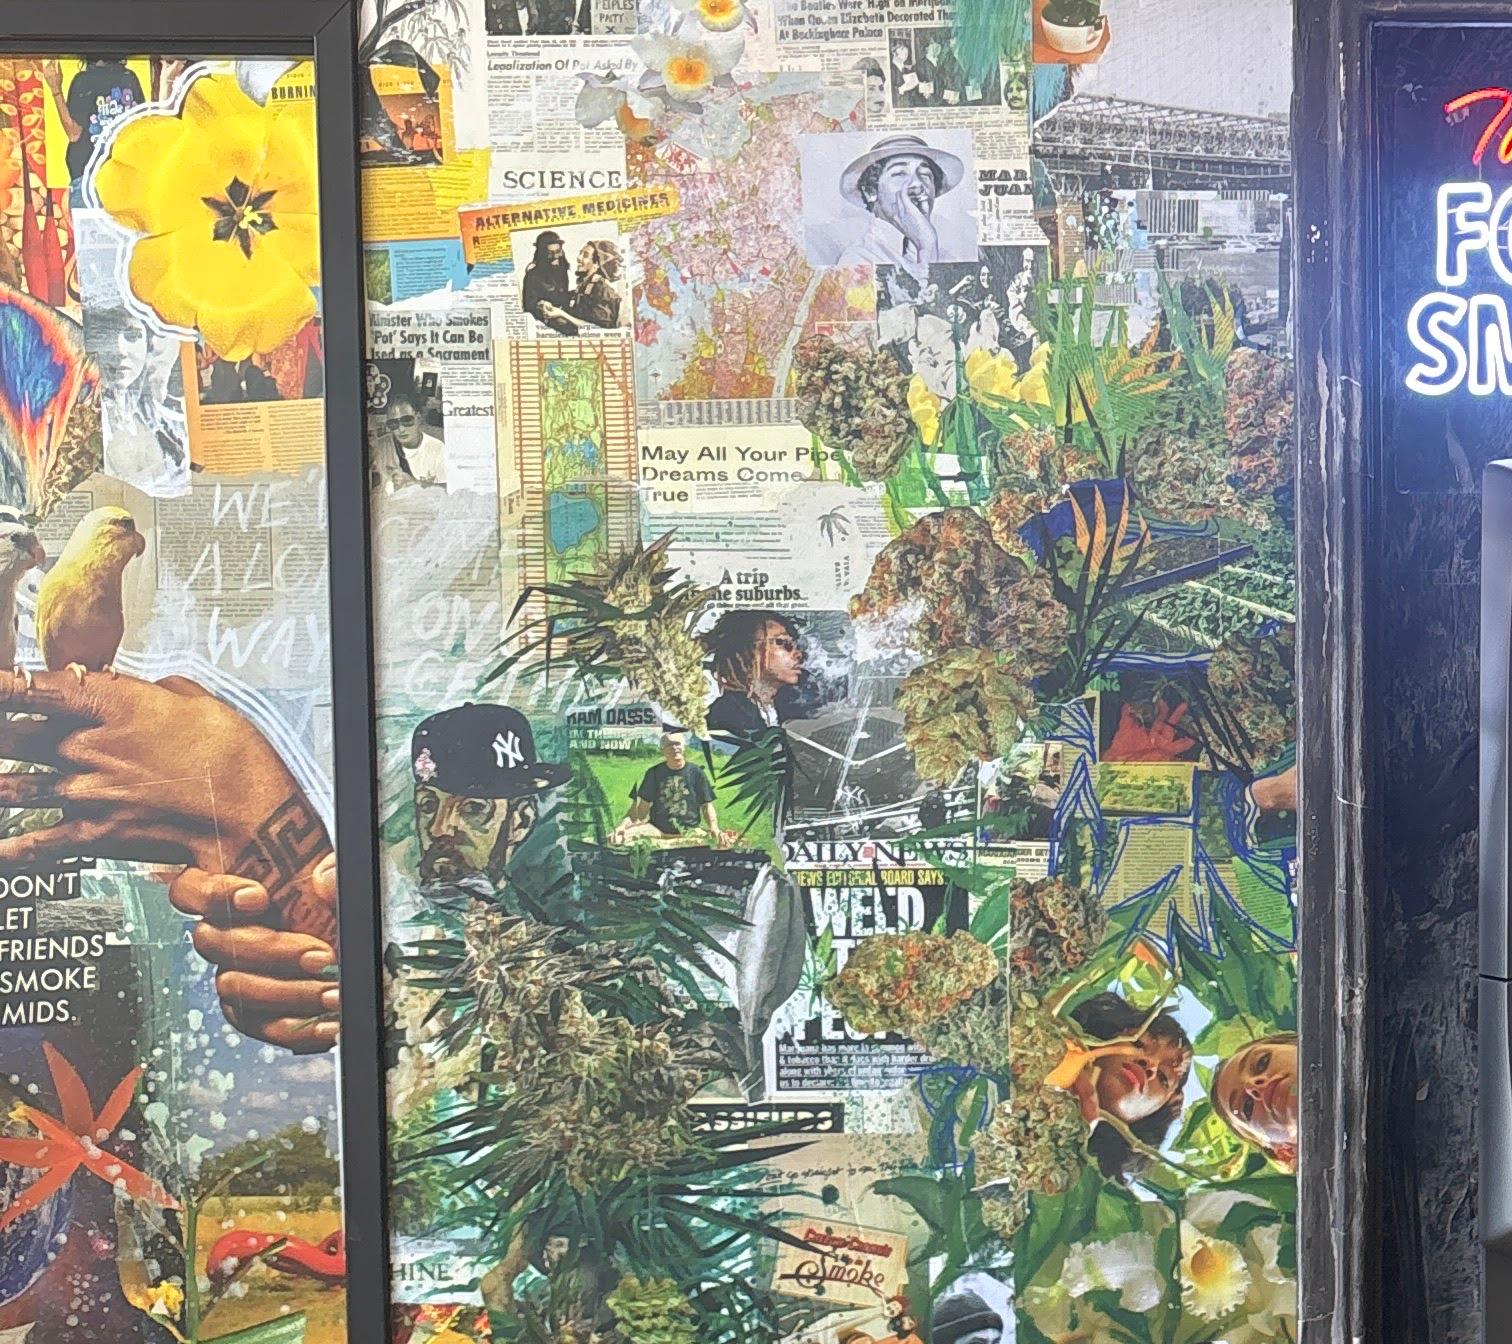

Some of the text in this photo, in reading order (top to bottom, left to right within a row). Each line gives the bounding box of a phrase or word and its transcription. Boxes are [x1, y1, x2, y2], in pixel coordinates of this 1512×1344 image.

[893, 0, 906, 8] on
[886, 10, 935, 24] Decorated
[487, 59, 553, 73] Legalization
[554, 59, 569, 71] Of
[503, 169, 623, 190] SCIENCE
[475, 192, 671, 231] ALTERNATIVE MEDICINES
[448, 313, 489, 327] Smokes
[400, 331, 428, 347] Says
[430, 331, 440, 343] It
[443, 330, 465, 344] Can
[468, 330, 484, 344] Be
[399, 347, 490, 361] as Sacrament
[441, 400, 495, 418] Greatest
[641, 445, 690, 464] May
[697, 445, 727, 462] All
[735, 446, 788, 462] Your
[641, 466, 806, 483] Dreams Come
[719, 567, 770, 589] A trip
[735, 585, 801, 601] suburbs
[491, 730, 525, 769] NY
[569, 739, 598, 750] AND
[0, 872, 79, 899] DON'T
[917, 869, 945, 886] SAYS
[0, 906, 34, 931] ET
[0, 934, 105, 962] FRIENDS
[0, 966, 98, 994] SMOKE
[2, 999, 78, 1026] MIDS.
[795, 1254, 886, 1289] Smoke
